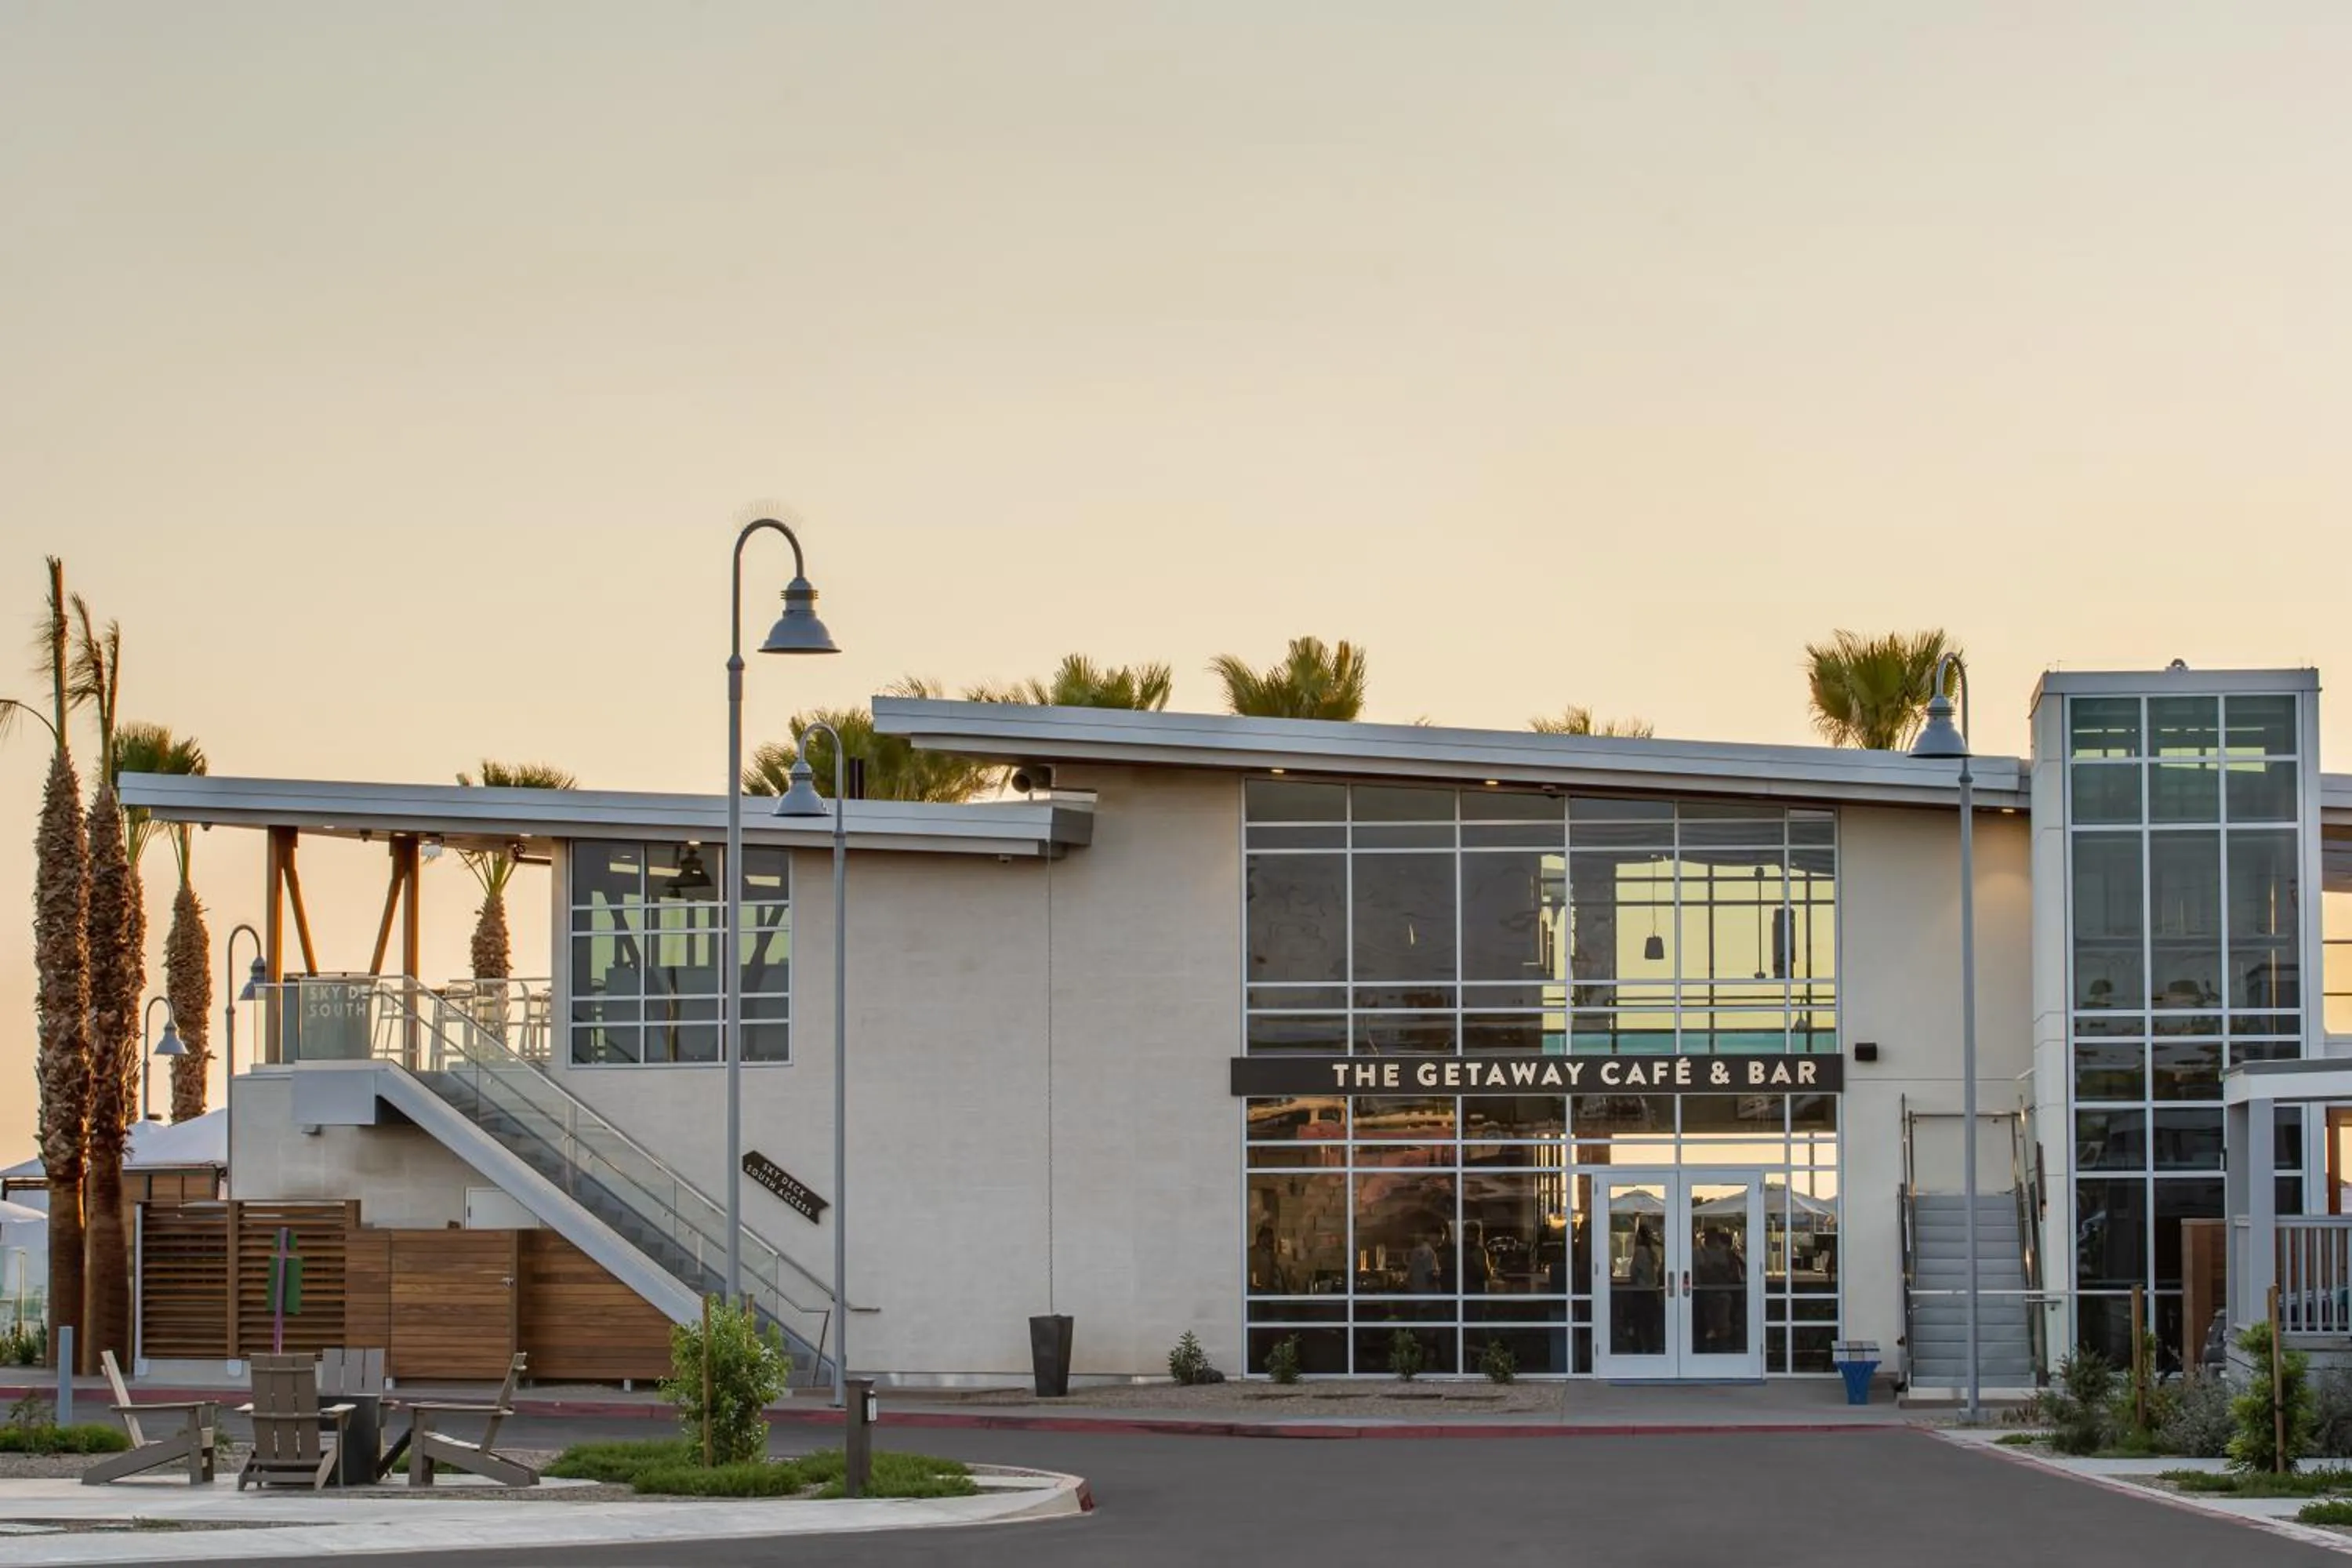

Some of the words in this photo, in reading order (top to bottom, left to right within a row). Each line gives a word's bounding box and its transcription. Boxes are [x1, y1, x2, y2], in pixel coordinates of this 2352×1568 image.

[309, 985, 341, 1000] SKY
[309, 1004, 366, 1017] SOUTH
[1333, 1063, 1399, 1087] THE
[1417, 1062, 1584, 1086] GETAWAY
[1601, 1058, 1691, 1085] CAFÉ
[1710, 1061, 1730, 1084] &
[1748, 1061, 1817, 1084] BAR
[746, 1164, 777, 1189] SOUTH
[777, 1188, 812, 1215] ACCESS
[762, 1163, 781, 1178] SKY
[782, 1177, 805, 1197] DECK
